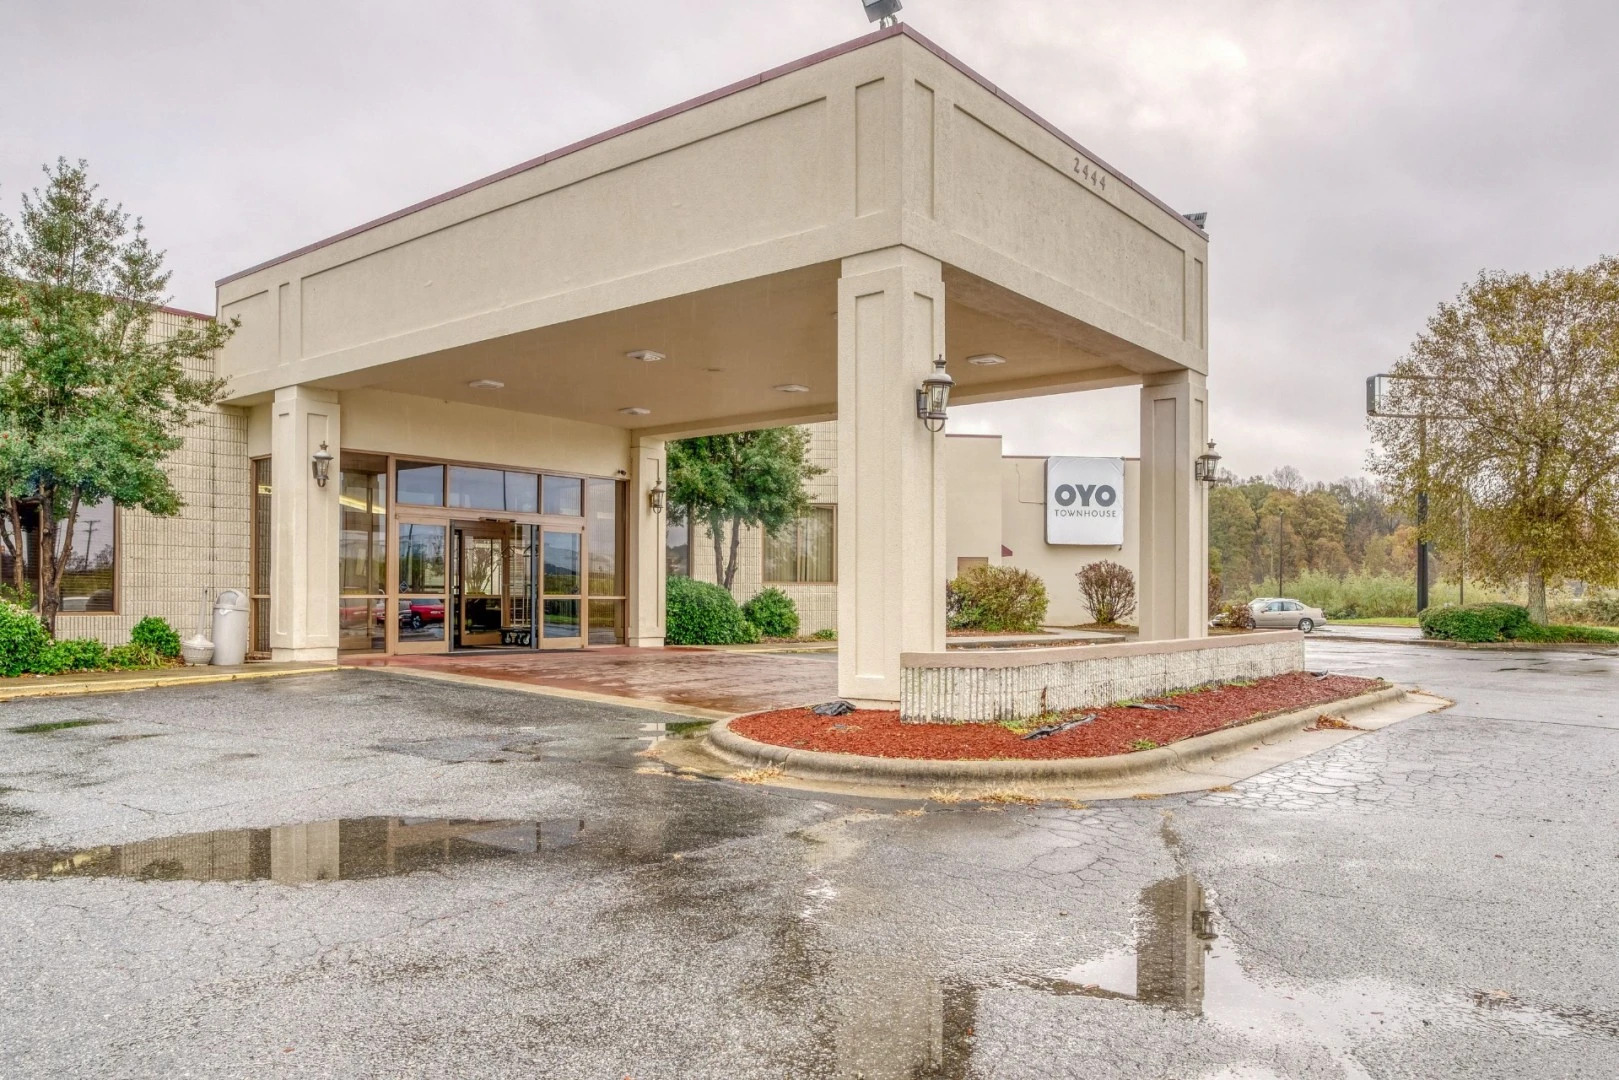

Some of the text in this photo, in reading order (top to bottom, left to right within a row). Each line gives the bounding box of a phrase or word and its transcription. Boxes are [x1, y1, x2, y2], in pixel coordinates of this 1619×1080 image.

[1073, 157, 1106, 191] 2444
[1054, 484, 1117, 507] OYO
[1054, 509, 1117, 518] TOWNHOUSE
